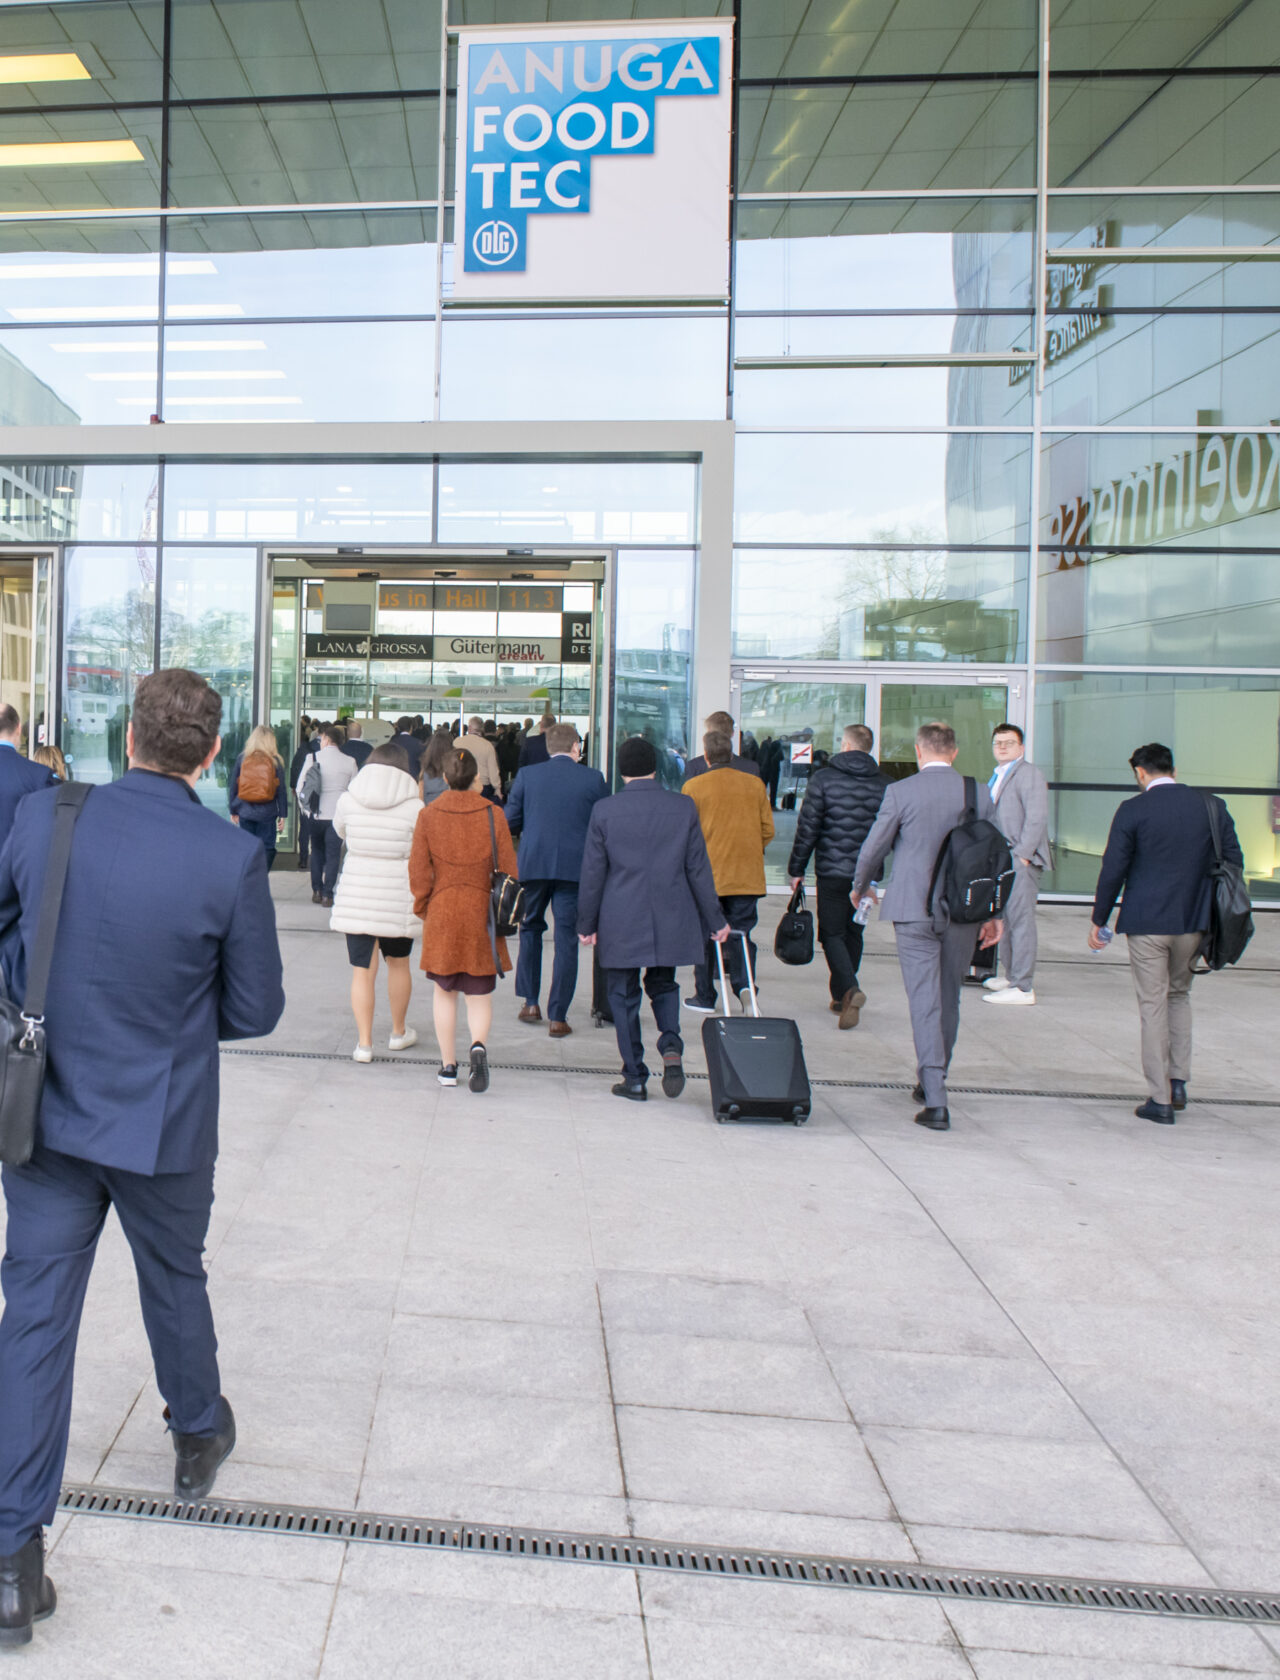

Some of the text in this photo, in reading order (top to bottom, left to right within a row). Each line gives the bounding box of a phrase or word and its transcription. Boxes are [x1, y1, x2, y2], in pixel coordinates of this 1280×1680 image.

[473, 41, 714, 95] ANUGA
[473, 101, 650, 152] FOOD
[471, 160, 582, 210] TEC
[481, 222, 510, 255] DLG
[408, 589, 427, 607] in
[445, 588, 487, 609] Hall
[508, 590, 555, 609] 11.3
[317, 641, 427, 655] LANA GROSSA
[450, 638, 541, 656] Gütermann
[499, 651, 545, 661] creativ
[464, 687, 489, 695] Security
